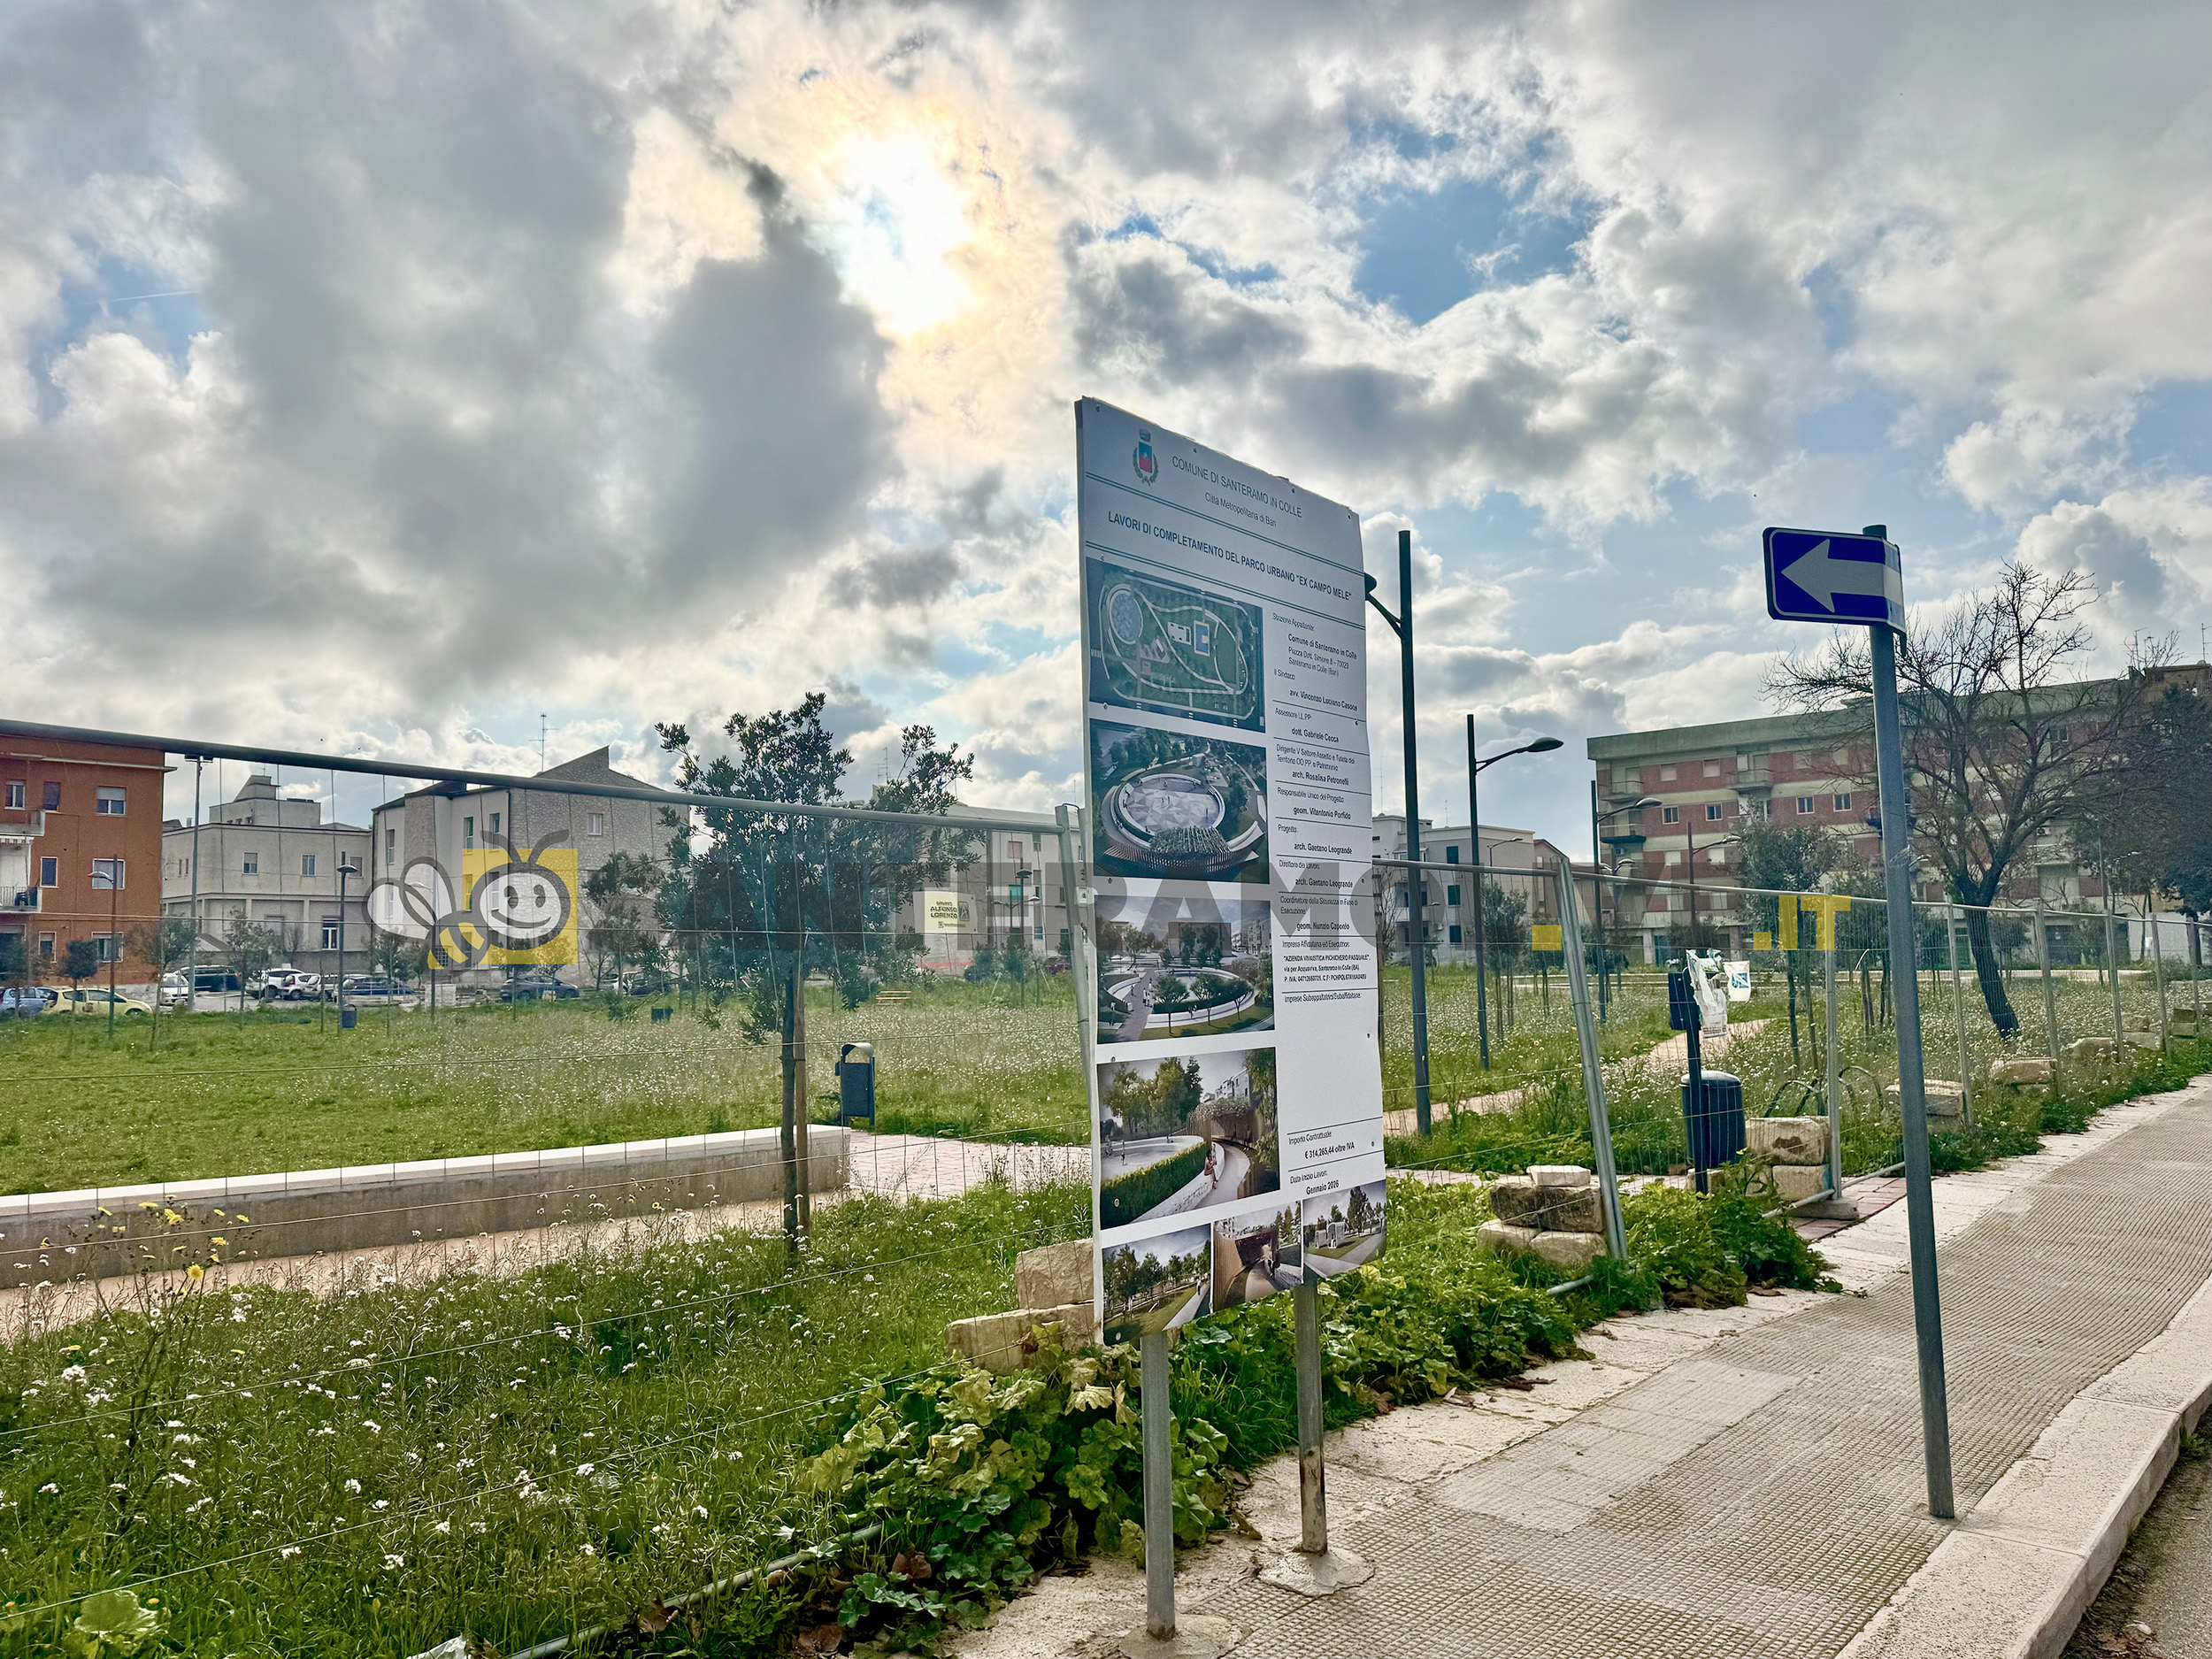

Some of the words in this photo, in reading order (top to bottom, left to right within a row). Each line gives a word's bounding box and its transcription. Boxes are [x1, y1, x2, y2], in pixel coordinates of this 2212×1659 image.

[1172, 456, 1209, 480] COMUNE
[1210, 472, 1218, 484] DI
[1221, 476, 1269, 504] SANTERAMO
[1271, 497, 1277, 508] IN
[1279, 500, 1302, 518] COLLE
[1205, 492, 1219, 505] Città
[1221, 498, 1258, 520] Metropolitana
[1265, 516, 1277, 527] Bari
[1109, 511, 1140, 531] LAVORI
[1143, 523, 1151, 534] DI
[1154, 526, 1224, 558] COMPLETAMENTO
[1226, 550, 1240, 564] DEL
[1241, 556, 1265, 572] PARCO
[1267, 565, 1294, 582] URBANO
[1296, 575, 1308, 587] "EX
[1310, 580, 1332, 595] CAMPO
[1333, 588, 1351, 600] MELE"
[1288, 634, 1309, 646] Comune
[1315, 641, 1340, 655] Santeramo
[1346, 650, 1357, 659] Colle
[1288, 647, 1302, 657] Piazza
[1288, 657, 1311, 669] Santeramo
[1317, 664, 1327, 673] Colle
[1301, 691, 1322, 703] Vincenzo
[1275, 708, 1297, 718] Assessore
[1304, 729, 1324, 740] Gabriele
[1276, 744, 1296, 755] Dirigente
[1301, 749, 1317, 757] Settore
[1278, 787, 1306, 798] Responsabile
[1307, 791, 1319, 800] Unico
[1310, 808, 1333, 818] Vitantonio
[1334, 810, 1351, 819] Porfido
[1308, 843, 1327, 852] Gaetano
[1328, 845, 1353, 855] Leogrande
[1309, 878, 1328, 887] Gaetano
[1329, 879, 1353, 888] Leogrande
[1289, 1136, 1305, 1145] Importo
[1306, 1184, 1327, 1194] Gennaio
[1328, 1179, 1340, 1189] 2026
